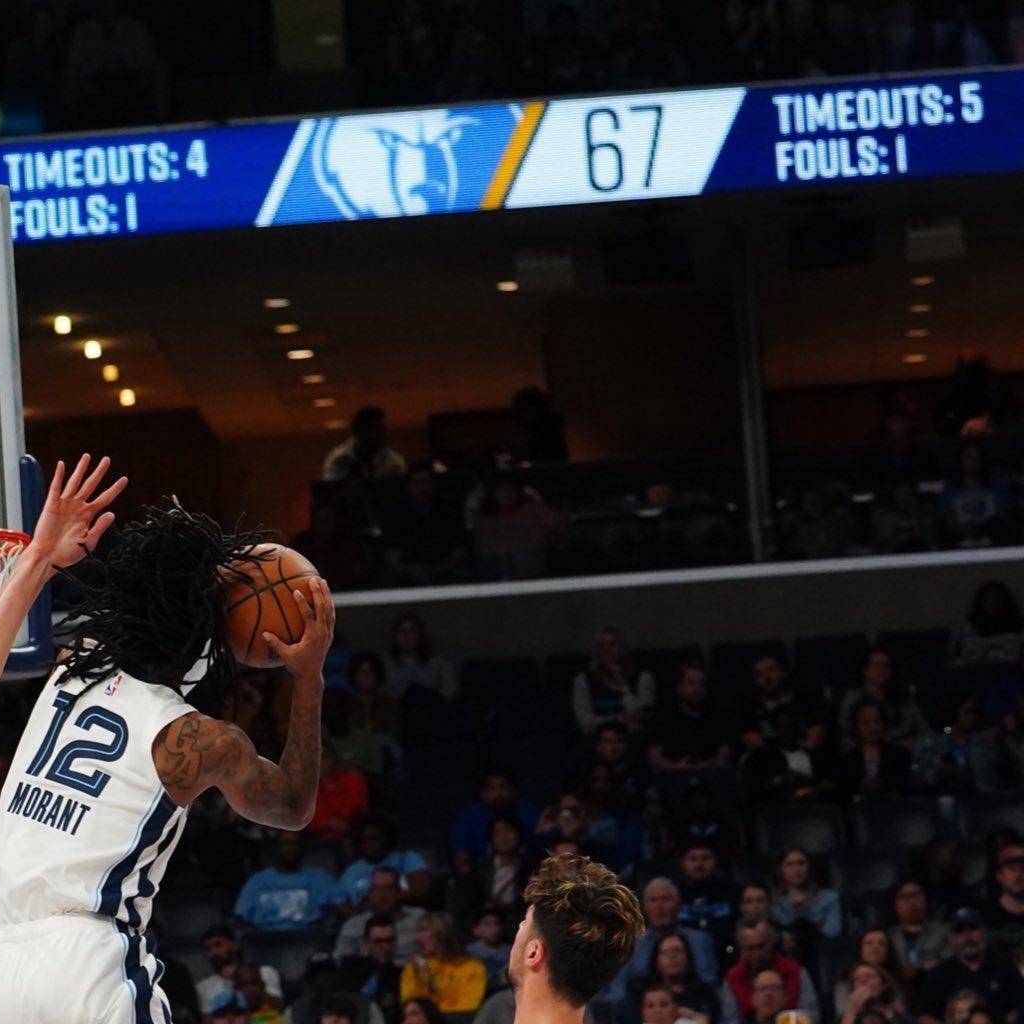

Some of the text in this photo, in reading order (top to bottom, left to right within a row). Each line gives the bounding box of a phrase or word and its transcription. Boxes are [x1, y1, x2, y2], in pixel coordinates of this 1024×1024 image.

[772, 81, 985, 136] TIMEOUTS: 5
[3, 139, 208, 193] TIMEOUTS: 4
[585, 105, 664, 193] 67
[774, 135, 890, 182] FOULS:
[10, 193, 118, 241] FOULS:
[25, 689, 129, 799] 12
[7, 781, 92, 836] MORANT
